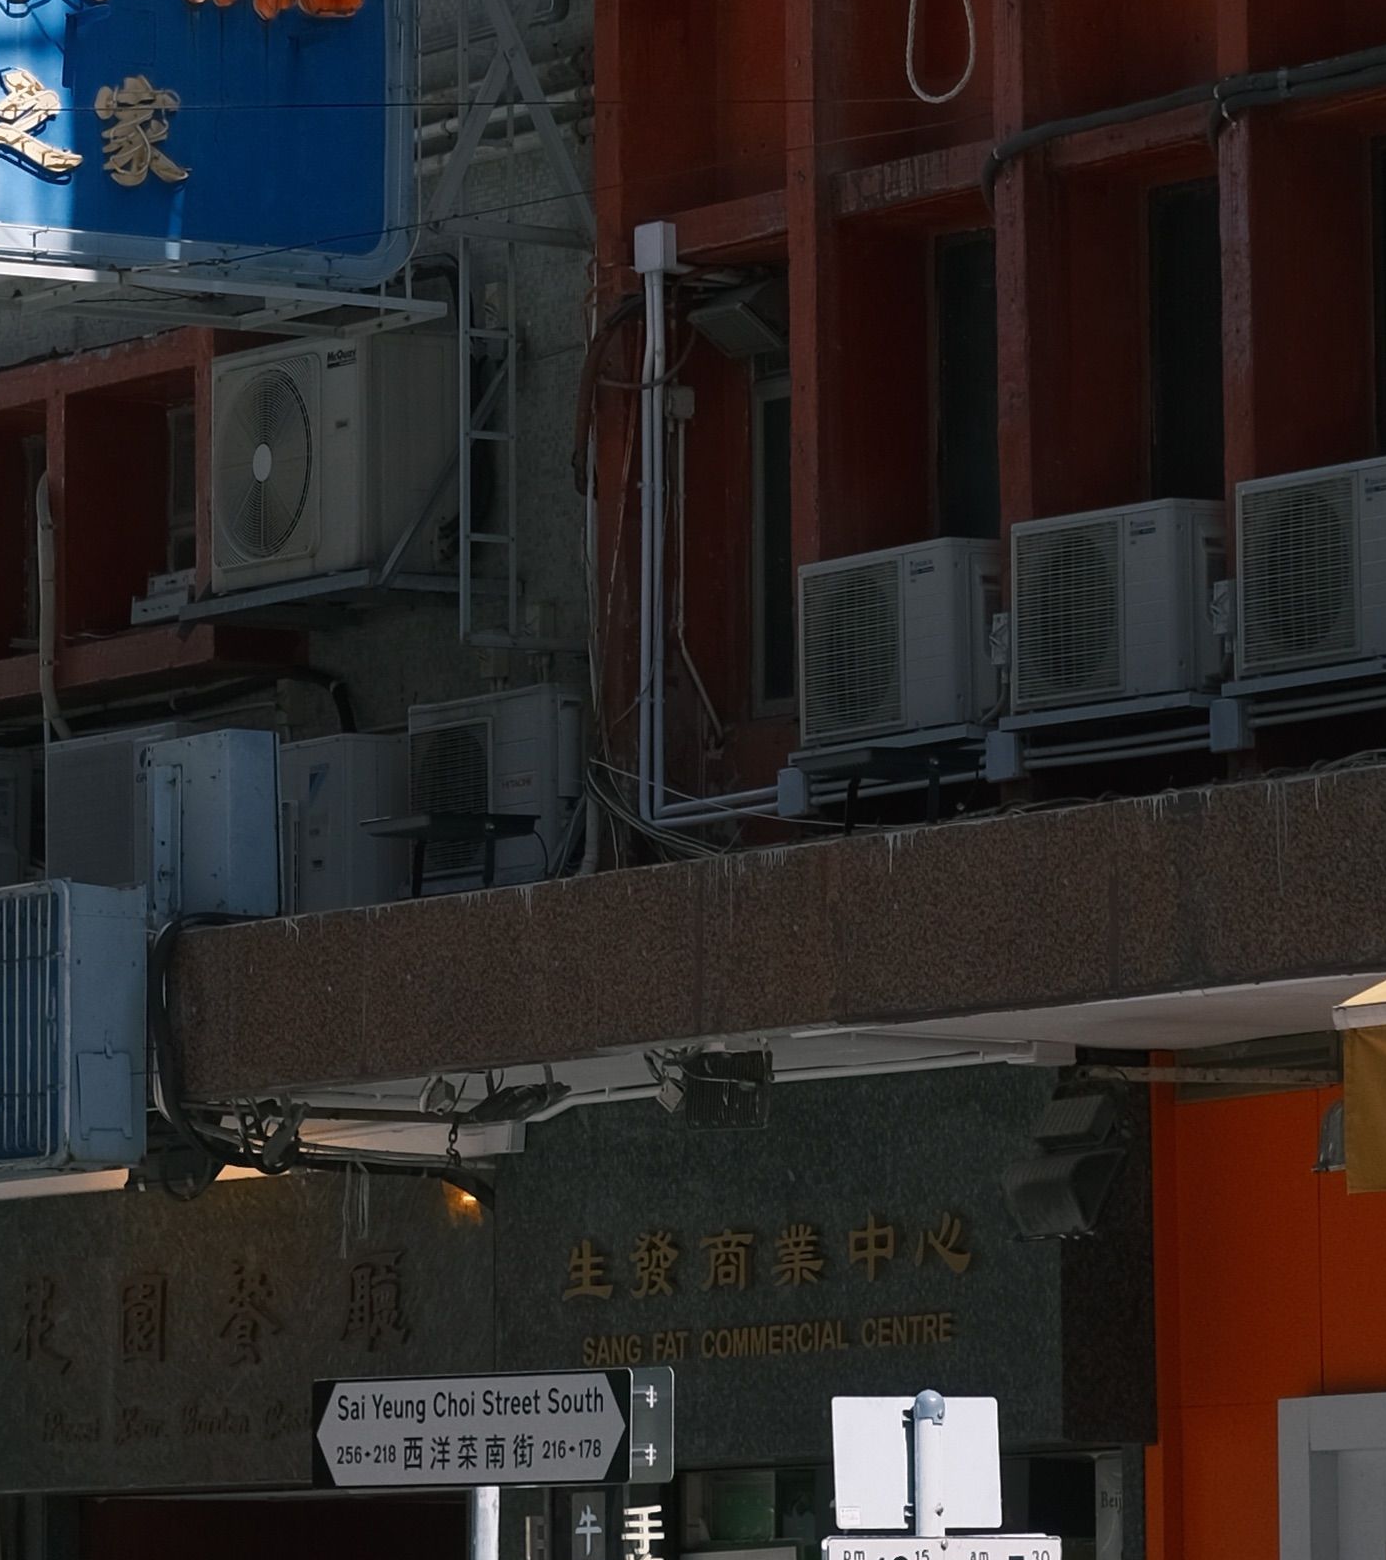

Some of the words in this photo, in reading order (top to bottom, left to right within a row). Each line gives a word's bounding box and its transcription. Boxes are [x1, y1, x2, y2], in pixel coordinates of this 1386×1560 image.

[562, 1209, 972, 1303] 生發商業中心
[582, 1333, 642, 1367] SANG
[652, 1331, 689, 1362] FAT
[700, 1320, 849, 1360] COMMERCIAL
[861, 1311, 954, 1349] CENTRE
[337, 1394, 366, 1421] Sai
[371, 1393, 426, 1423] Yeung
[433, 1391, 476, 1418] Choi
[482, 1389, 541, 1416] Street
[548, 1387, 605, 1414] South
[403, 1434, 534, 1471] 西洋菜南街
